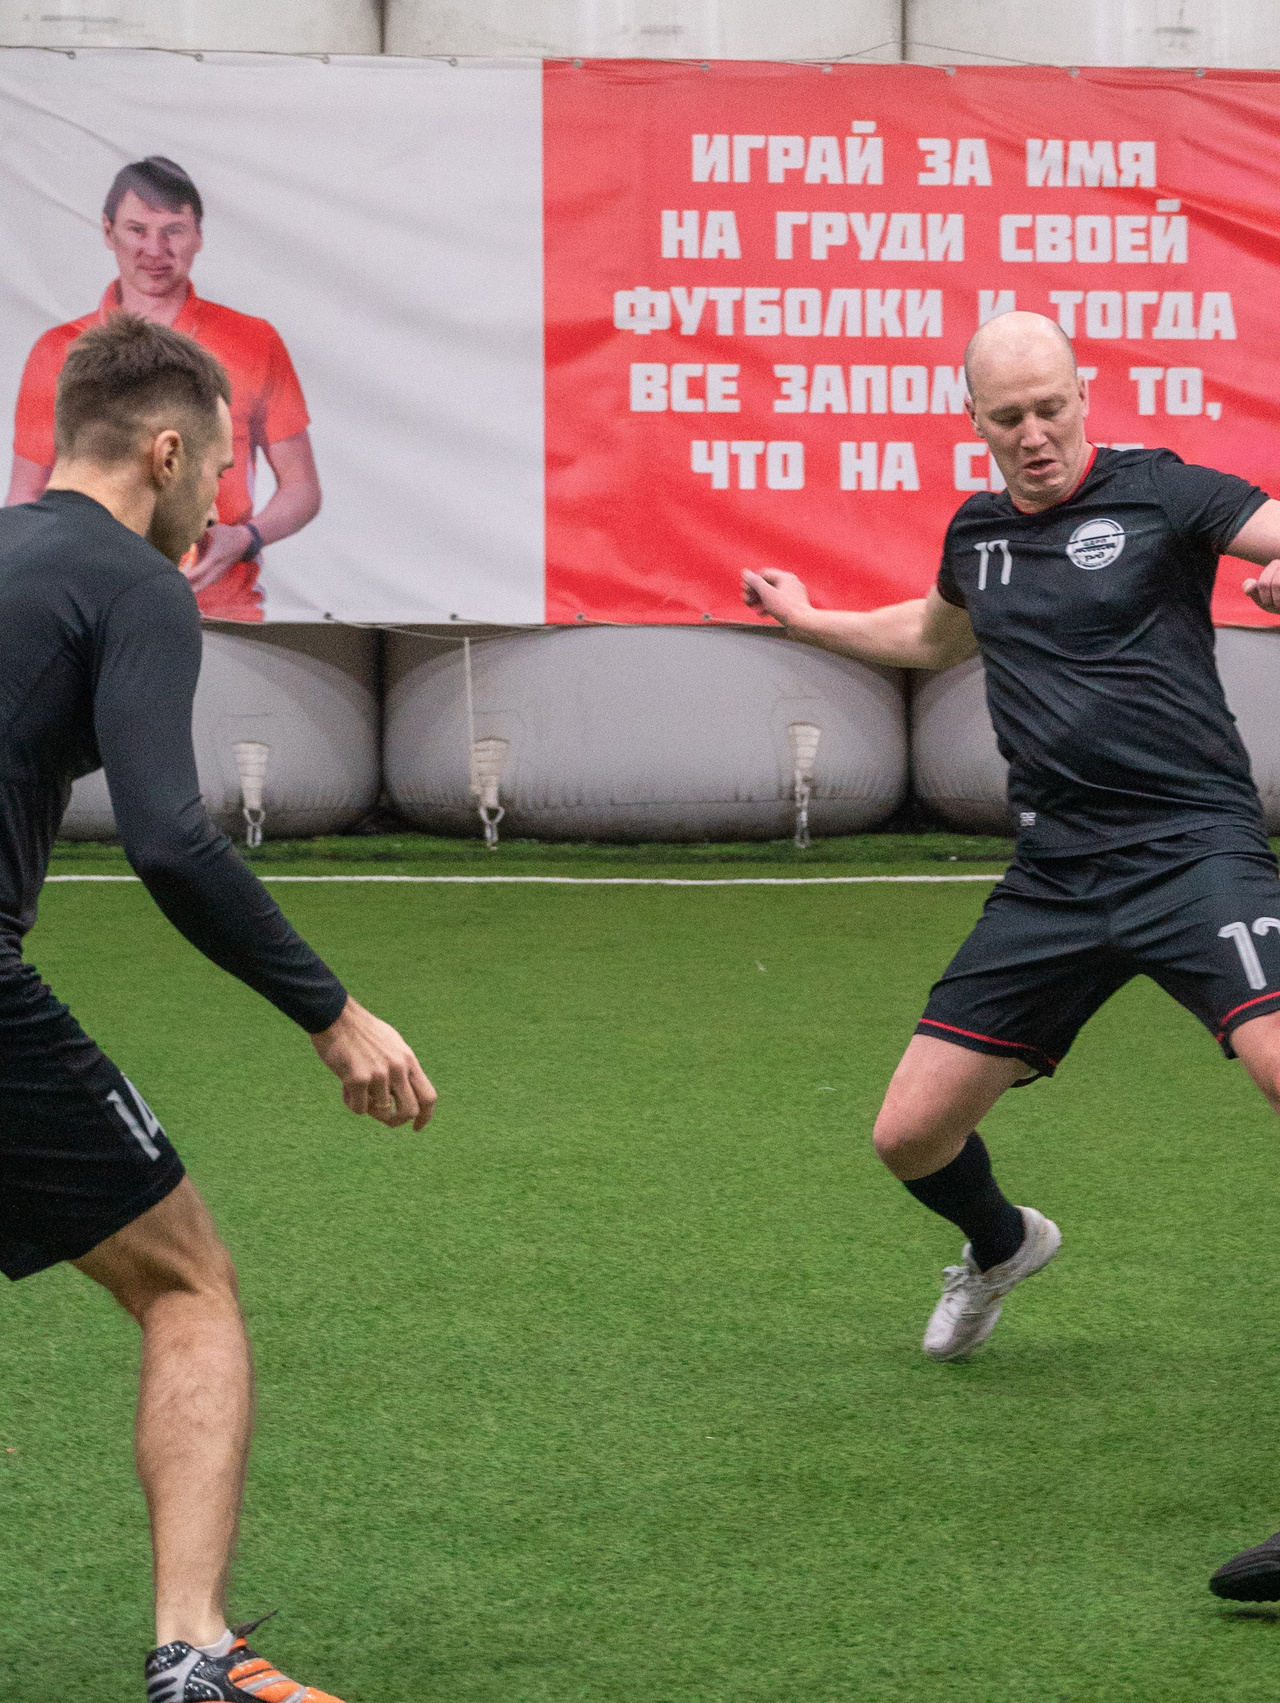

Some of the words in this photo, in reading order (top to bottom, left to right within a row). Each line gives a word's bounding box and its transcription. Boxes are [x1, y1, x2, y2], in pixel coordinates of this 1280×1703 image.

[691, 120, 884, 186] ИГРАЙ
[917, 137, 993, 187] ЗА
[1026, 138, 1157, 188] ИМЯ
[661, 209, 742, 260] НА
[775, 210, 965, 262] ГРУДИ
[999, 199, 1188, 264] СВОЕЙ
[613, 286, 943, 338] ФУТБОЛКИ
[1049, 291, 1237, 341] ТОГДА
[629, 362, 741, 413] ВСЕ
[1129, 366, 1222, 421] ТО,
[690, 440, 805, 491] ЧТО
[839, 441, 920, 491] НА
